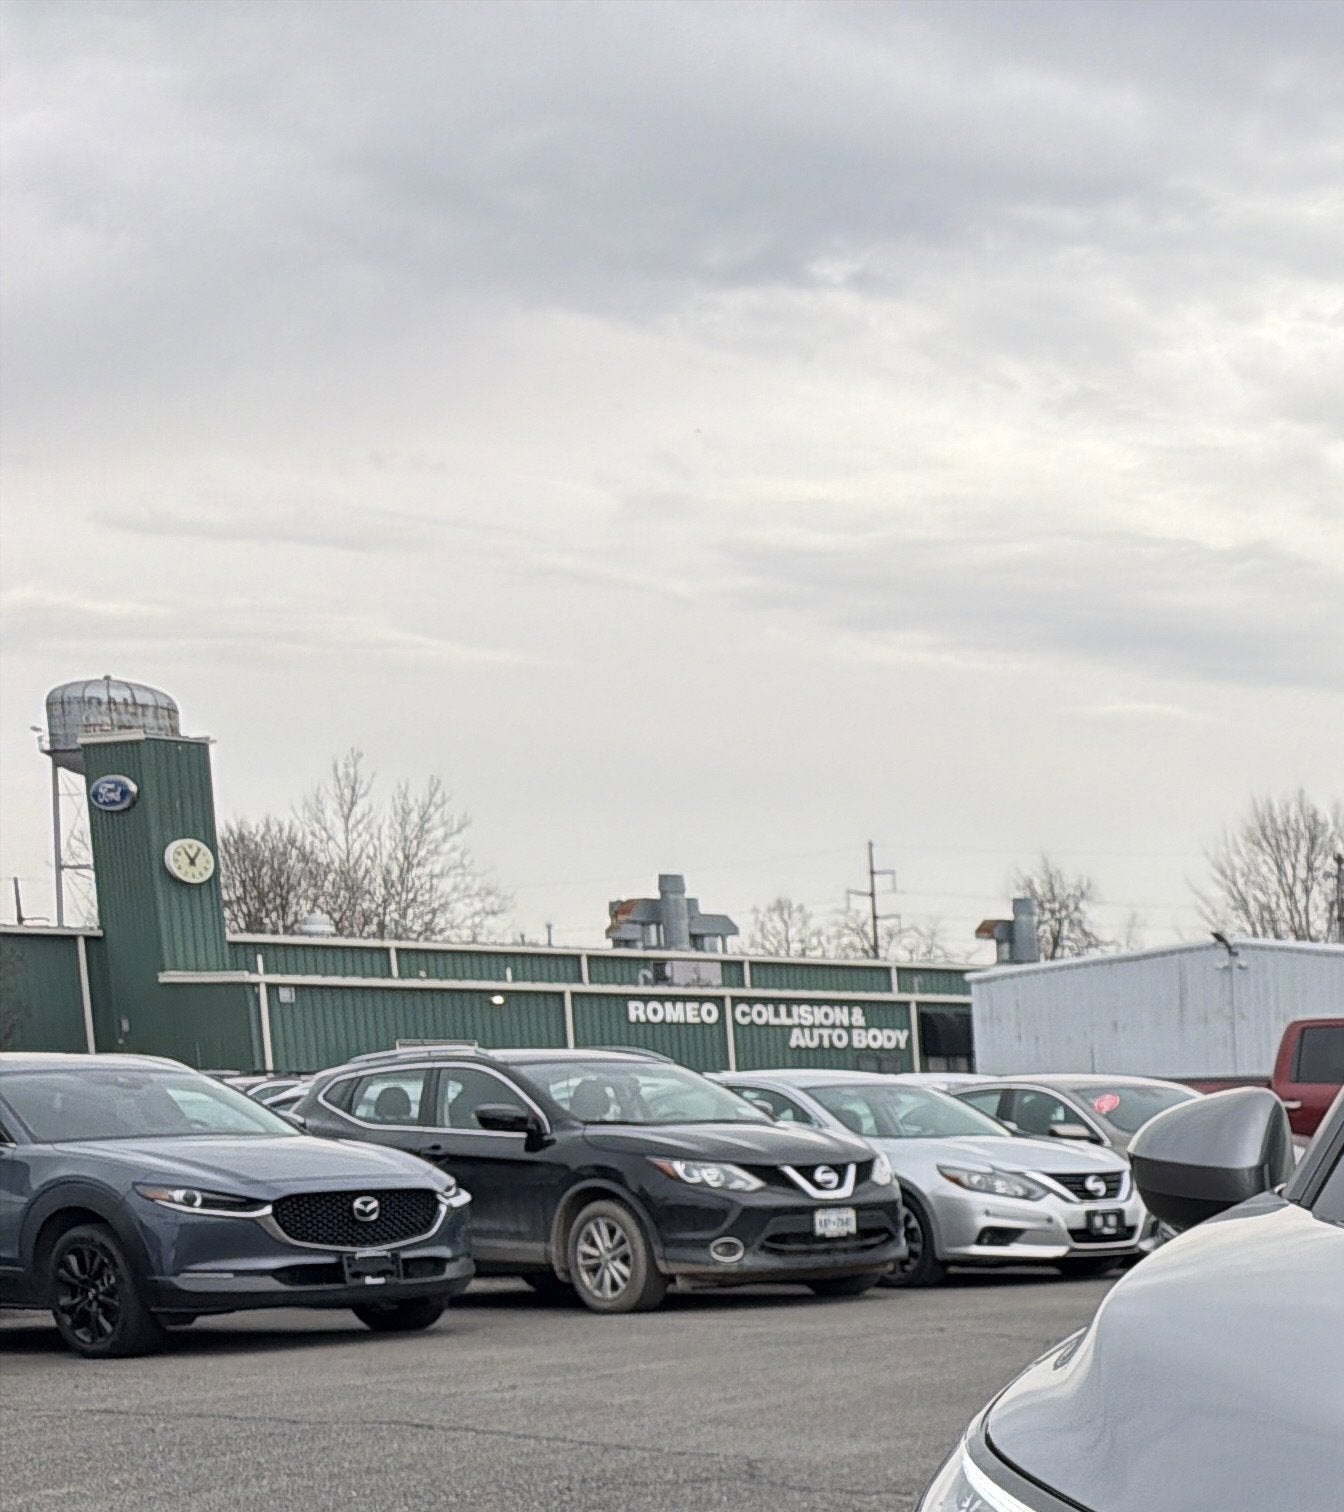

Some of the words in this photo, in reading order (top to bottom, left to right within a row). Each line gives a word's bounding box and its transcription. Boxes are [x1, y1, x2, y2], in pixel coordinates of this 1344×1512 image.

[627, 1001, 719, 1024] ROMEO
[734, 1003, 849, 1027] COLLISION
[850, 1006, 866, 1027] &
[789, 1028, 848, 1049] AUTO
[851, 1028, 909, 1049] BODY
